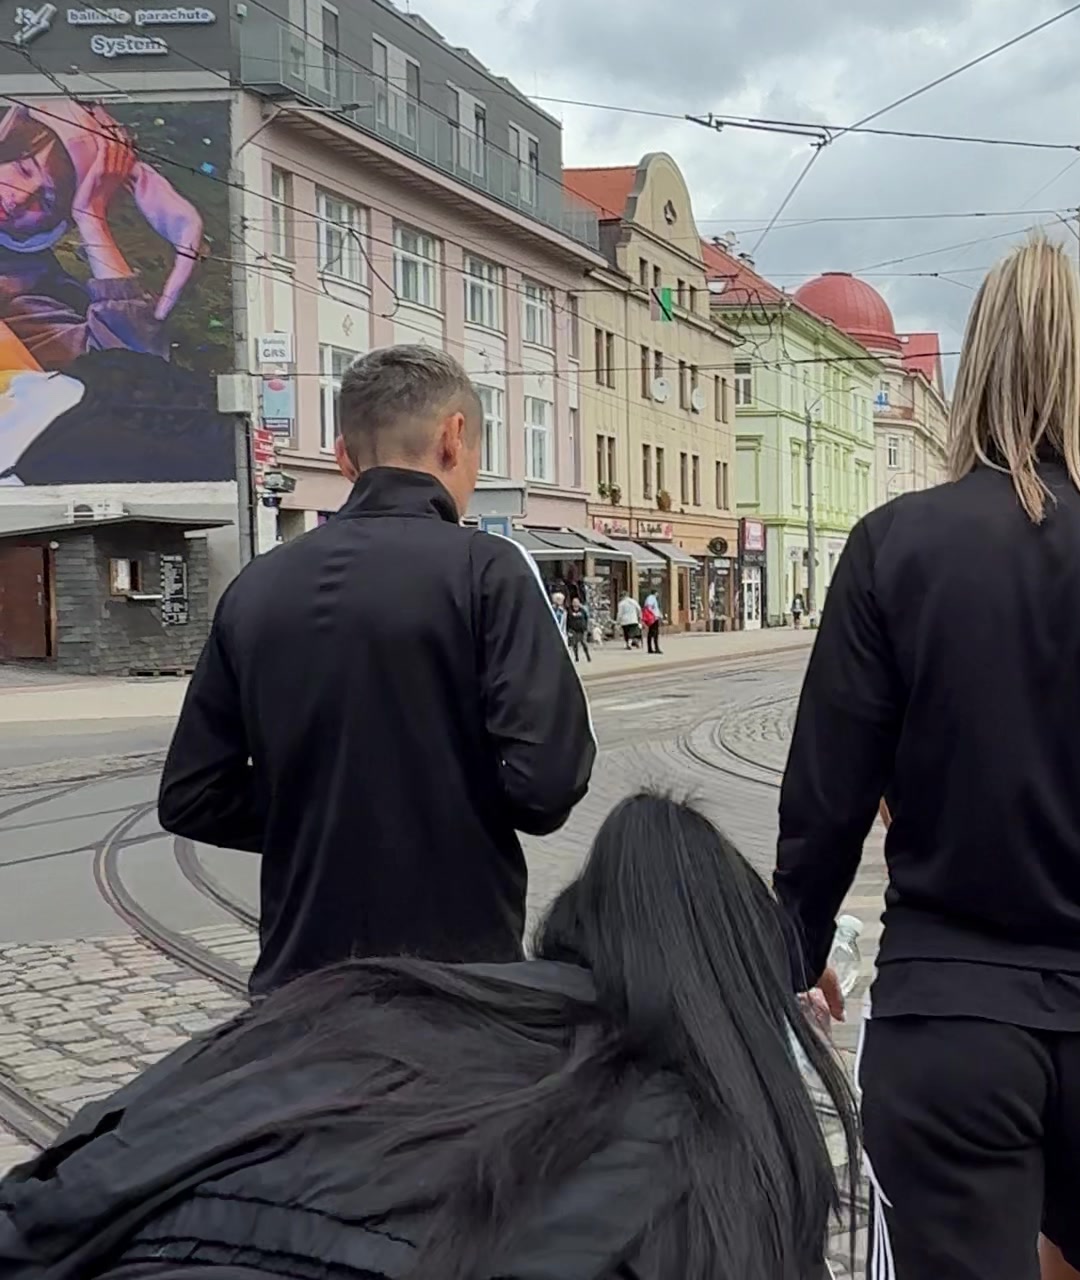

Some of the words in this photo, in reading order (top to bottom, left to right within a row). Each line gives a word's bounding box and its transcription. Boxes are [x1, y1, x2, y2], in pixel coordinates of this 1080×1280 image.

[69, 10, 126, 22] ballic
[137, 9, 210, 23] parachute
[93, 36, 163, 55] System
